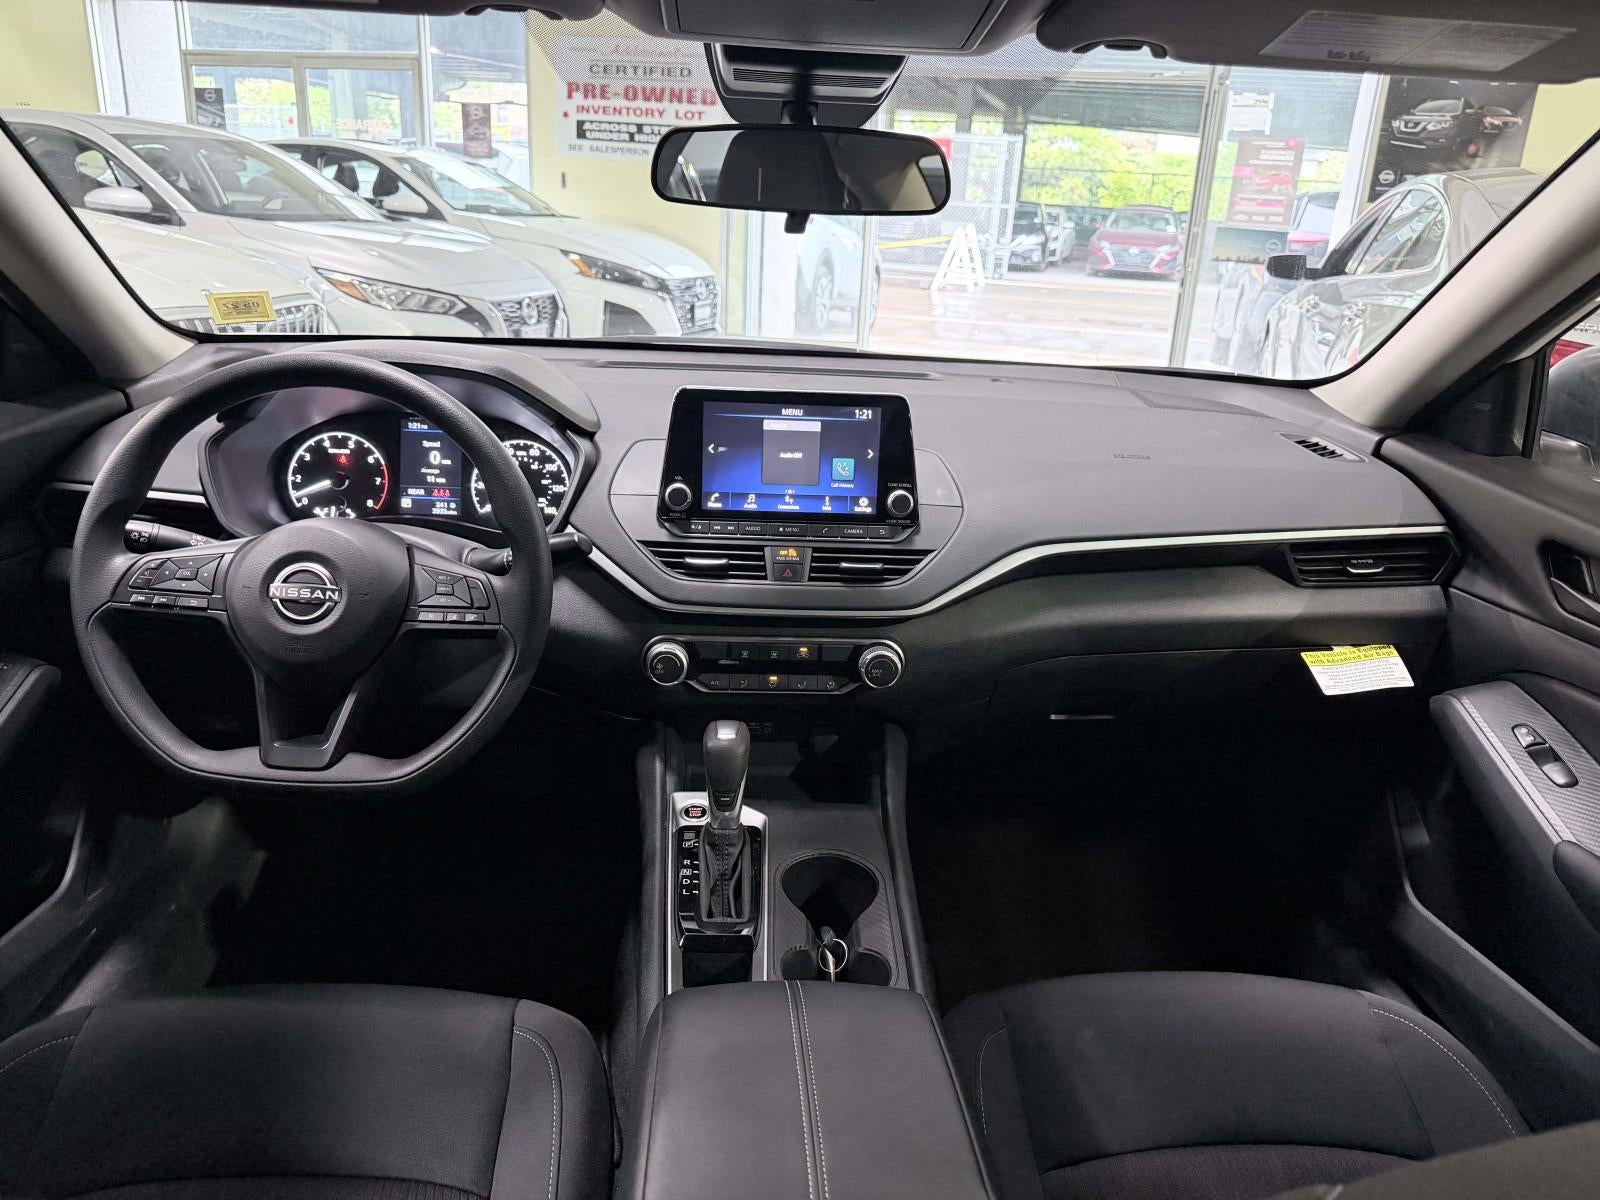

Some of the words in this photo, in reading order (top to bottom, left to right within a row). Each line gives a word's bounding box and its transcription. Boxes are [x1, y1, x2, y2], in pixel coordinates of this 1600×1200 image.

[588, 63, 692, 78] CERTIFIED
[566, 81, 717, 106] PRE-OWNED
[576, 105, 665, 119] INVENTORY
[674, 110, 706, 121] LOT
[582, 121, 638, 134] ACROSS
[584, 130, 630, 141] UNDER
[781, 408, 803, 417] MENU
[854, 408, 873, 420] 1:21
[303, 452, 311, 461] 3
[367, 455, 375, 464] 6
[429, 450, 441, 465] 0
[544, 463, 558, 472] 100
[374, 477, 382, 486] 7
[366, 499, 374, 507] 8
[269, 587, 339, 600] NISSAN
[1357, 645, 1391, 654] Equipped
[1327, 656, 1361, 664] Advanced
[1376, 650, 1394, 658] Bags
